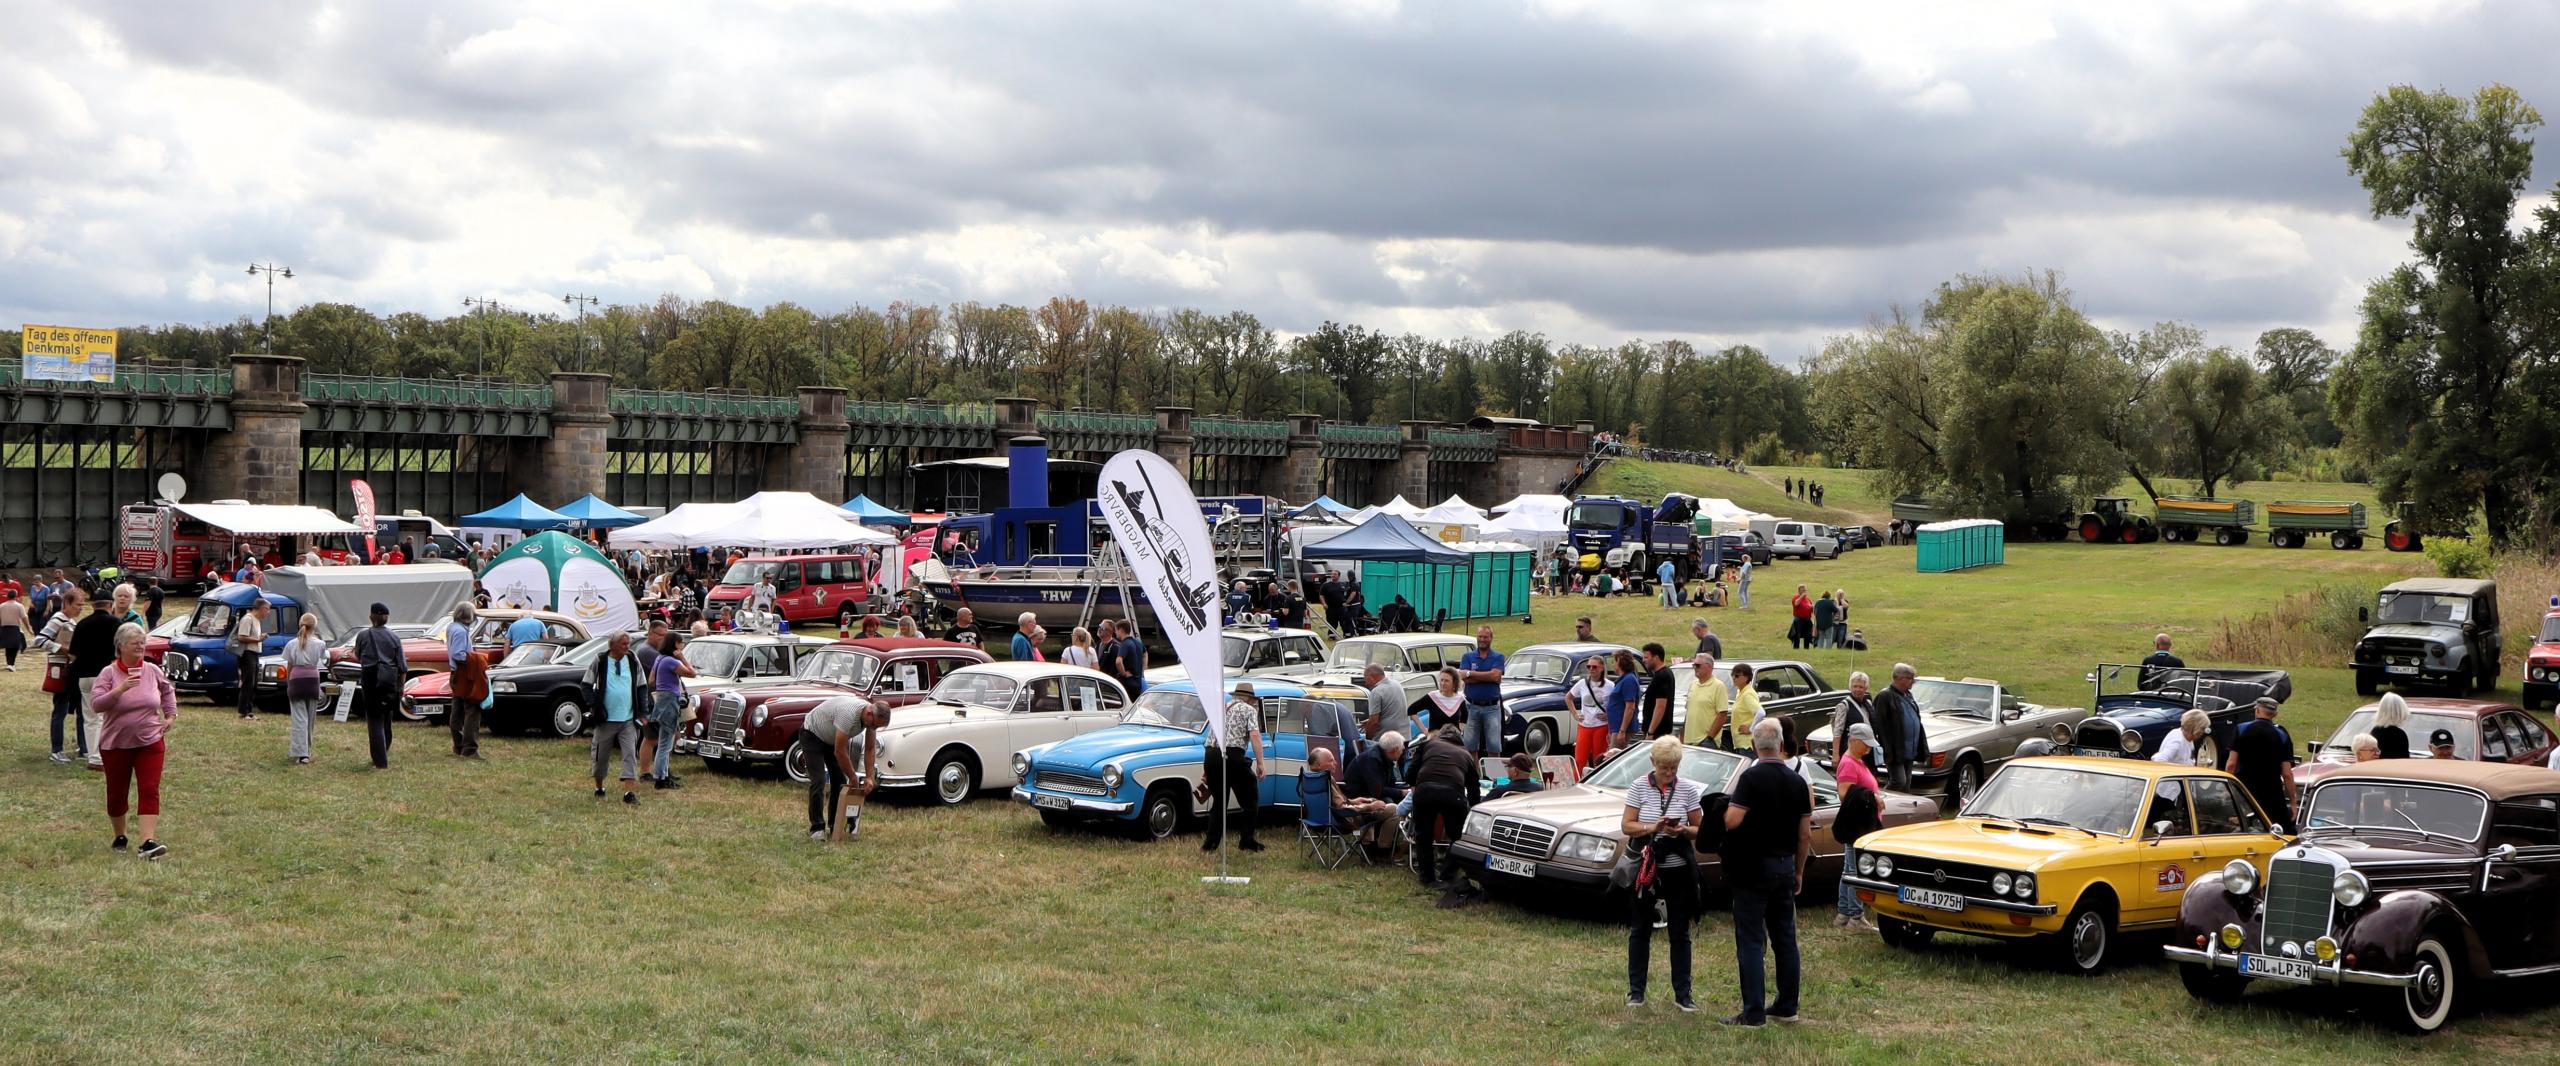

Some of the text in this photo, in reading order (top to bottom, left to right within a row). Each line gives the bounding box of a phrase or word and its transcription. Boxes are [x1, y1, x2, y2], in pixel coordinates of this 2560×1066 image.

[27, 327, 113, 345] Tag des offenen
[376, 524, 389, 532] OR
[1040, 590, 1072, 601] THW
[1490, 855, 1505, 870] WMS
[1904, 888, 1916, 901] OC
[1932, 892, 1962, 909] 1975H
[2248, 958, 2270, 973] SDL
